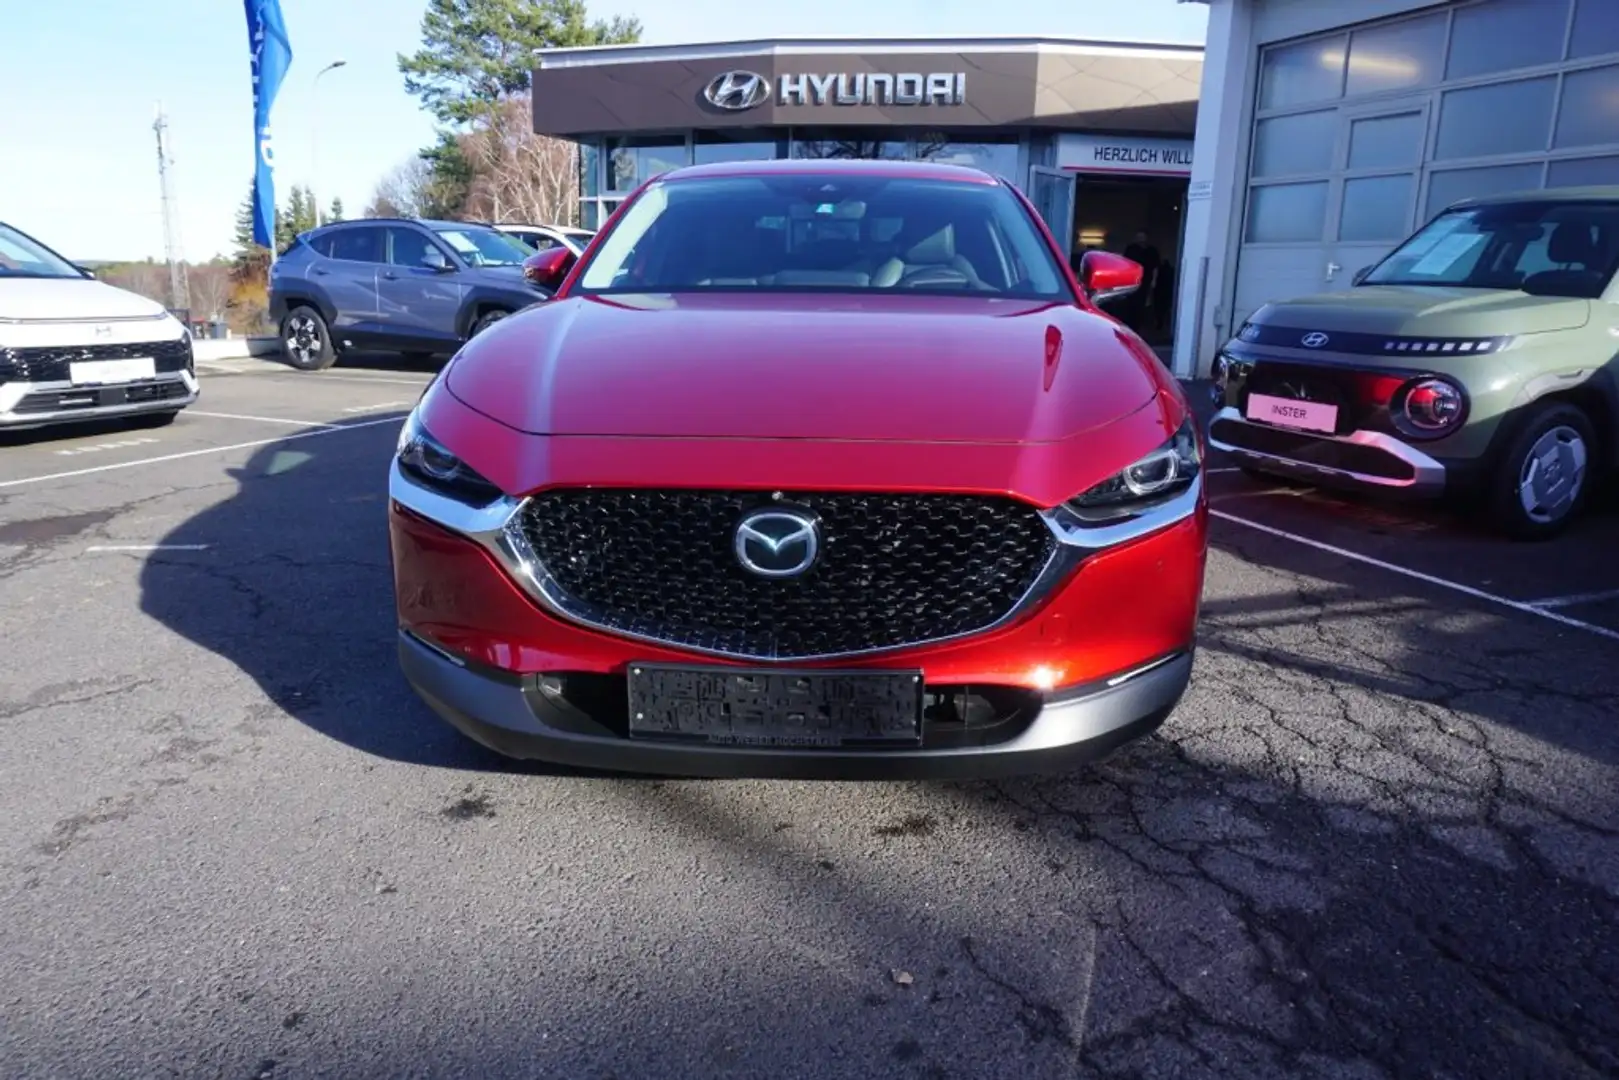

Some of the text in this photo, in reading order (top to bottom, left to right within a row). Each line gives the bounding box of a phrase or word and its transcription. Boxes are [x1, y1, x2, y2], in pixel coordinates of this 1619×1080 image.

[780, 72, 965, 104] HYUNDAI
[1094, 146, 1157, 163] HERZLICH
[1272, 405, 1308, 419] INSTER
